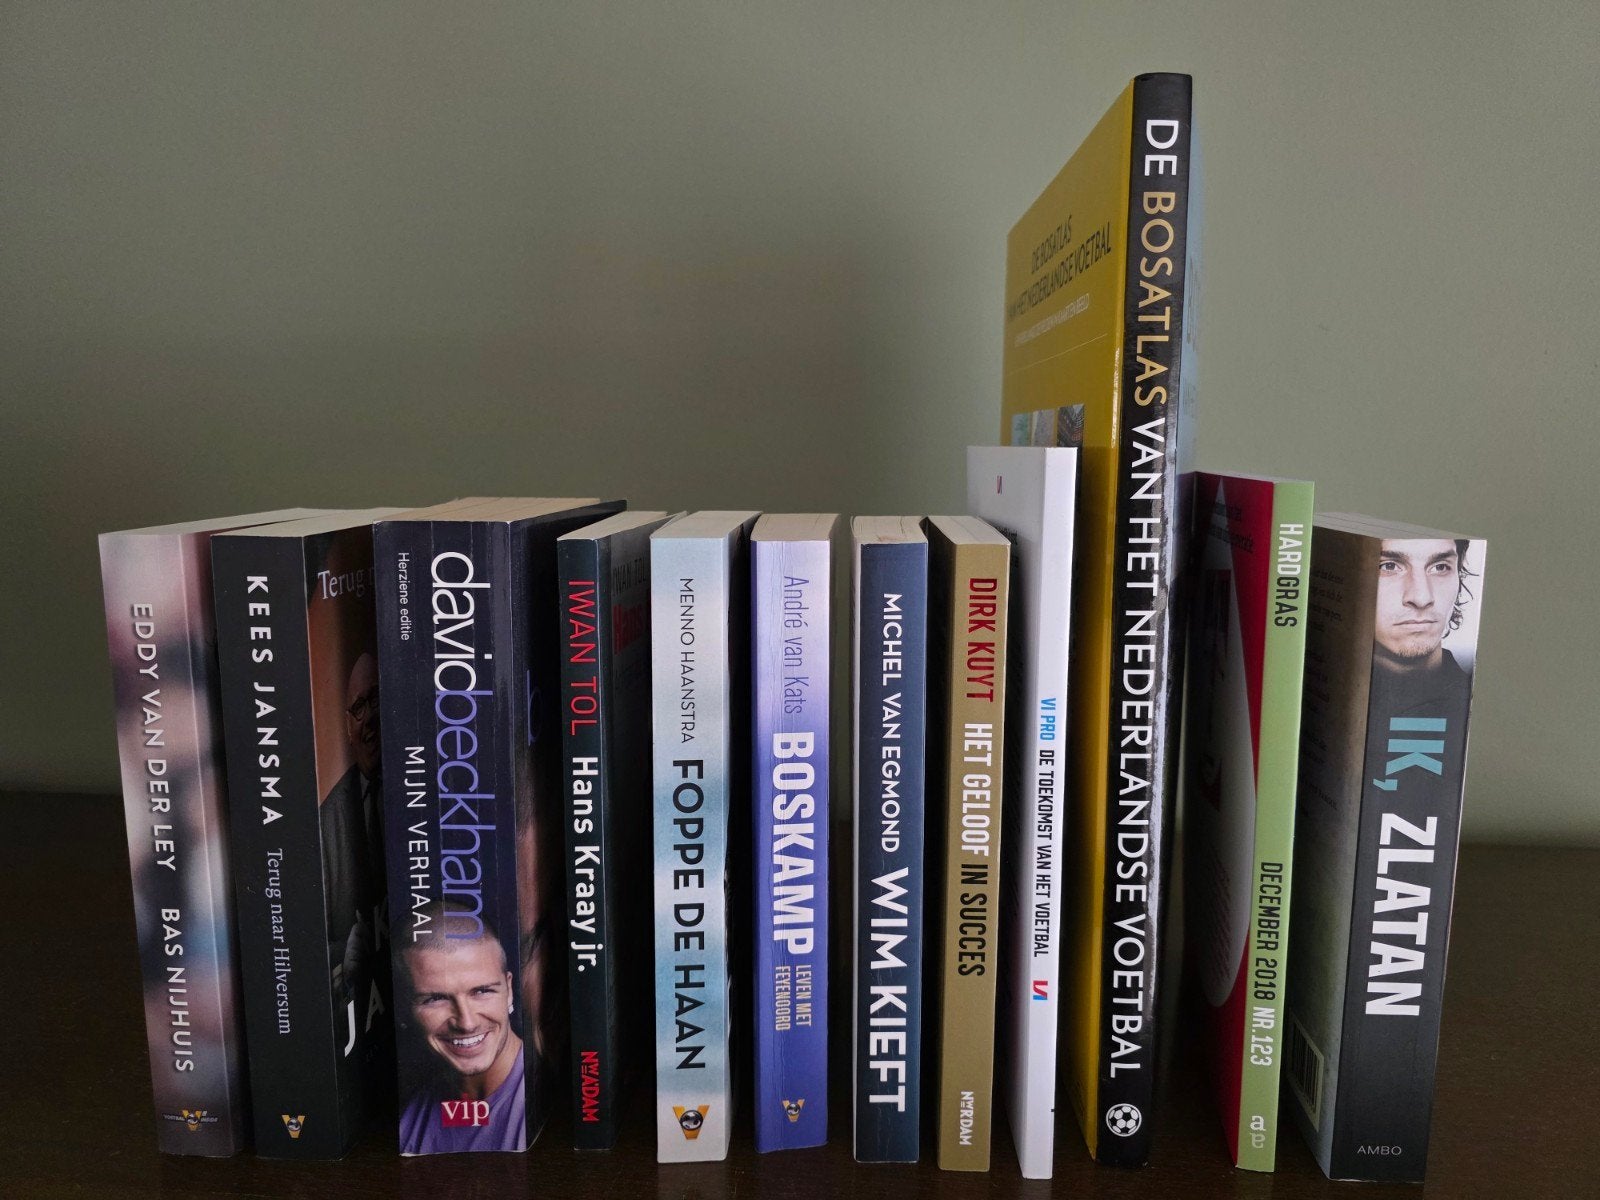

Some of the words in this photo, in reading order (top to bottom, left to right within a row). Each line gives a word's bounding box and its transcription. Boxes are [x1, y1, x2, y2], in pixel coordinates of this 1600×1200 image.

[1144, 118, 1179, 177] DE
[1074, 221, 1112, 281] VOETBAL
[1134, 190, 1177, 408] BOSATLAS
[1130, 417, 1166, 501] VAN
[317, 567, 366, 600] Terug
[396, 551, 409, 607] Herziene
[1126, 516, 1161, 597] HET
[1274, 523, 1304, 629] HARDGRAS
[246, 575, 274, 665] KEES
[399, 607, 410, 642] editie
[567, 580, 597, 664] IWAN
[679, 577, 696, 646] MENNO
[783, 575, 810, 630] André
[968, 577, 998, 634] DIRK
[131, 602, 161, 680] EDDY
[784, 635, 802, 668] van
[882, 592, 903, 687] MICHEL
[680, 651, 696, 744] HAANSTRA
[784, 675, 810, 715] Kats
[966, 641, 995, 703] KUYT
[140, 688, 165, 747] VAN
[569, 674, 599, 737] TOL
[882, 691, 902, 739] VAN
[1039, 715, 1056, 741] PRO
[1040, 697, 1056, 713] VI
[253, 680, 284, 826] JANSMA
[963, 722, 993, 767] HET
[1039, 749, 1055, 766] DE
[1114, 608, 1156, 903] NEDERLANDSE
[1372, 717, 1447, 792] IK,
[146, 758, 171, 813] DER
[403, 746, 427, 808] MIJN
[571, 755, 600, 834] Hans
[880, 745, 901, 853] EGMOND
[1037, 771, 1054, 841] TOEKOMST
[672, 759, 705, 890] FOPPE
[772, 731, 815, 955] BOSKAMP
[960, 773, 992, 857] GELOOF
[152, 823, 177, 873] LEY
[266, 848, 285, 899] Terug
[960, 863, 989, 885] IN
[1037, 844, 1052, 871] VAN
[406, 820, 433, 942] VERHAAL
[571, 844, 602, 935] Kraay
[1036, 875, 1051, 899] HET
[1255, 861, 1283, 950] DECEMBER
[160, 907, 184, 956] BAS
[269, 901, 285, 943] naar
[674, 902, 705, 952] DE
[869, 867, 909, 970] WIM
[958, 892, 988, 977] SUCCES
[1034, 903, 1050, 957] VOETBAL
[1364, 812, 1439, 1017] ZLATAN
[571, 941, 604, 973] jr.
[795, 963, 812, 1000] LEVEN
[1252, 956, 1276, 1001] 2018
[166, 966, 195, 1073] NIJHUIS
[271, 946, 292, 1035] Hilversum
[675, 964, 706, 1070] HAAN
[775, 965, 791, 1032] FEYENOORD
[796, 1002, 812, 1028] MET
[1110, 913, 1147, 1079] VOETBAL
[869, 985, 907, 1113] KIEFT
[441, 1092, 491, 1127] vip
[1356, 1144, 1403, 1157] AMBO
